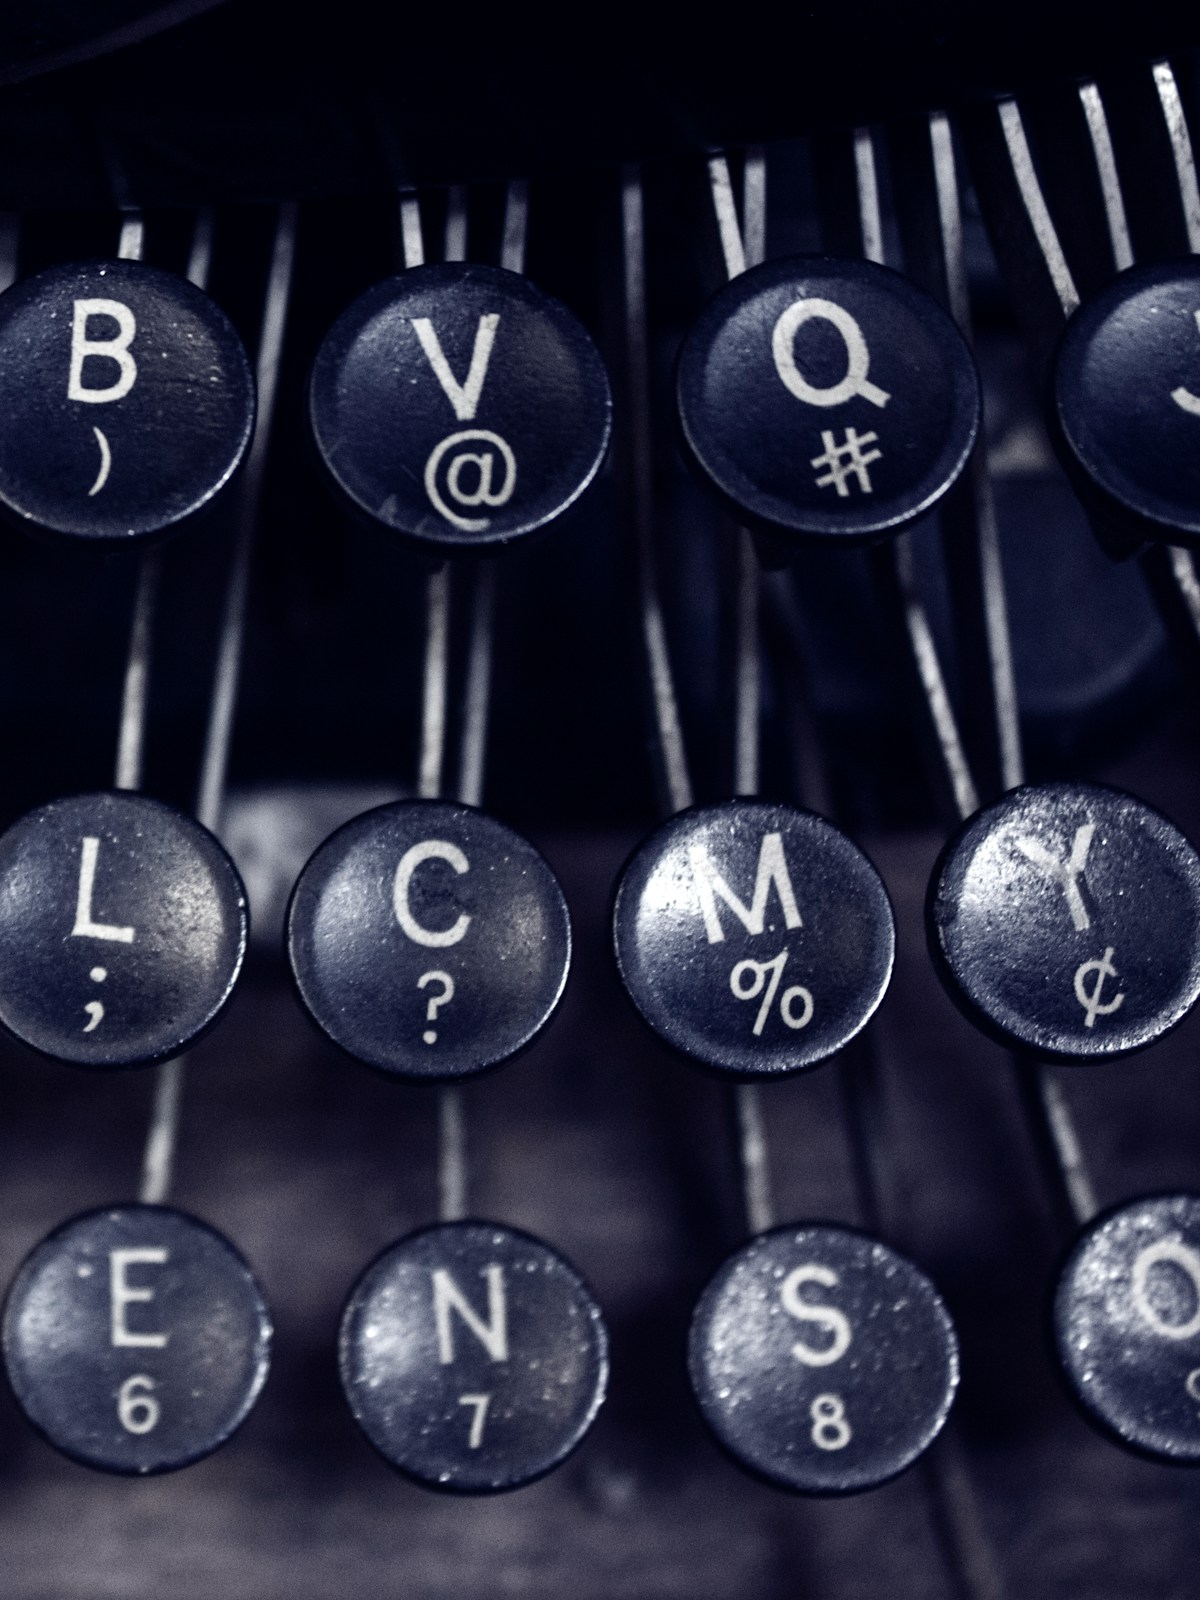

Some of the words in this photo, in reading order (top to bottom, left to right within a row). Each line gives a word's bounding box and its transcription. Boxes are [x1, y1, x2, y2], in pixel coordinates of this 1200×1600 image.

[68, 299, 136, 403] B
[410, 314, 499, 420] V
[772, 298, 891, 408] Q
[90, 427, 111, 495] )
[425, 429, 517, 531] @
[812, 428, 881, 496] #
[72, 838, 134, 943] L
[392, 840, 470, 947] C
[688, 832, 802, 944] M
[1016, 824, 1096, 932] Y
[84, 967, 107, 1032] ;
[417, 970, 454, 1044] ?
[730, 947, 813, 1035] %
[1074, 947, 1124, 1027] ¢
[110, 1248, 166, 1347] E
[432, 1265, 509, 1364] N
[781, 1265, 852, 1367] S
[119, 1375, 158, 1433] 6
[459, 1394, 489, 1448] 7
[810, 1394, 851, 1450] 8
